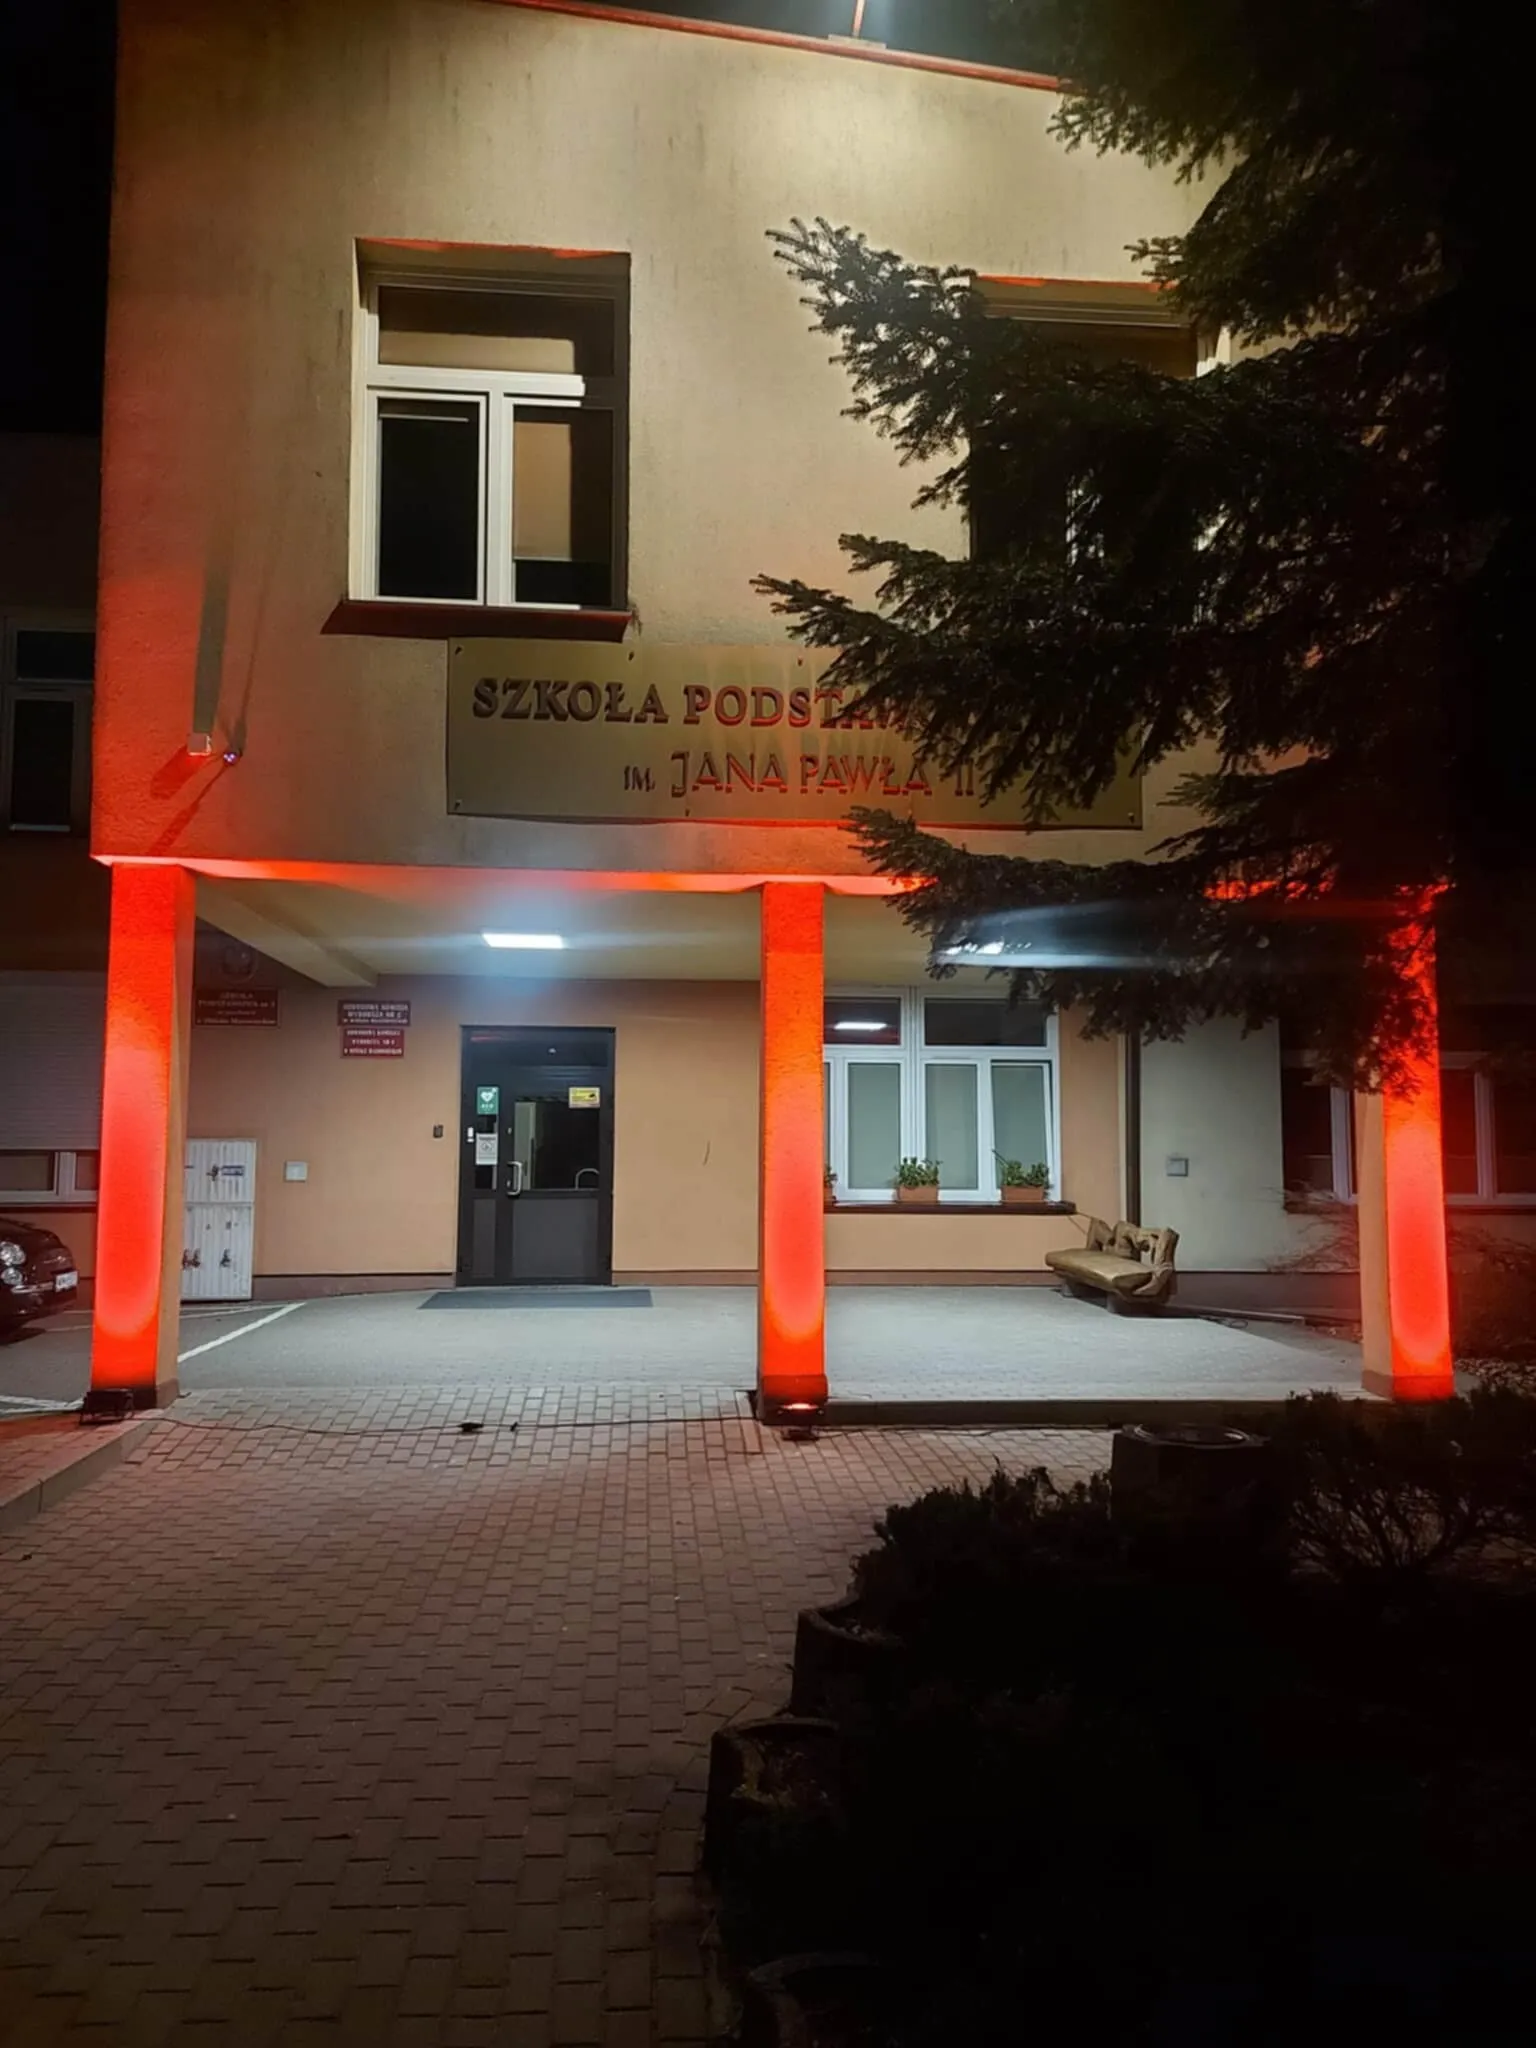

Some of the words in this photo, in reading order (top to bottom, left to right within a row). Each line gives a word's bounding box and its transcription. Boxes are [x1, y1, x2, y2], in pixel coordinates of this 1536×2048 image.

[473, 677, 669, 724] SZKOŁA
[671, 750, 788, 798] JANA
[800, 753, 933, 796] PAWŁA
